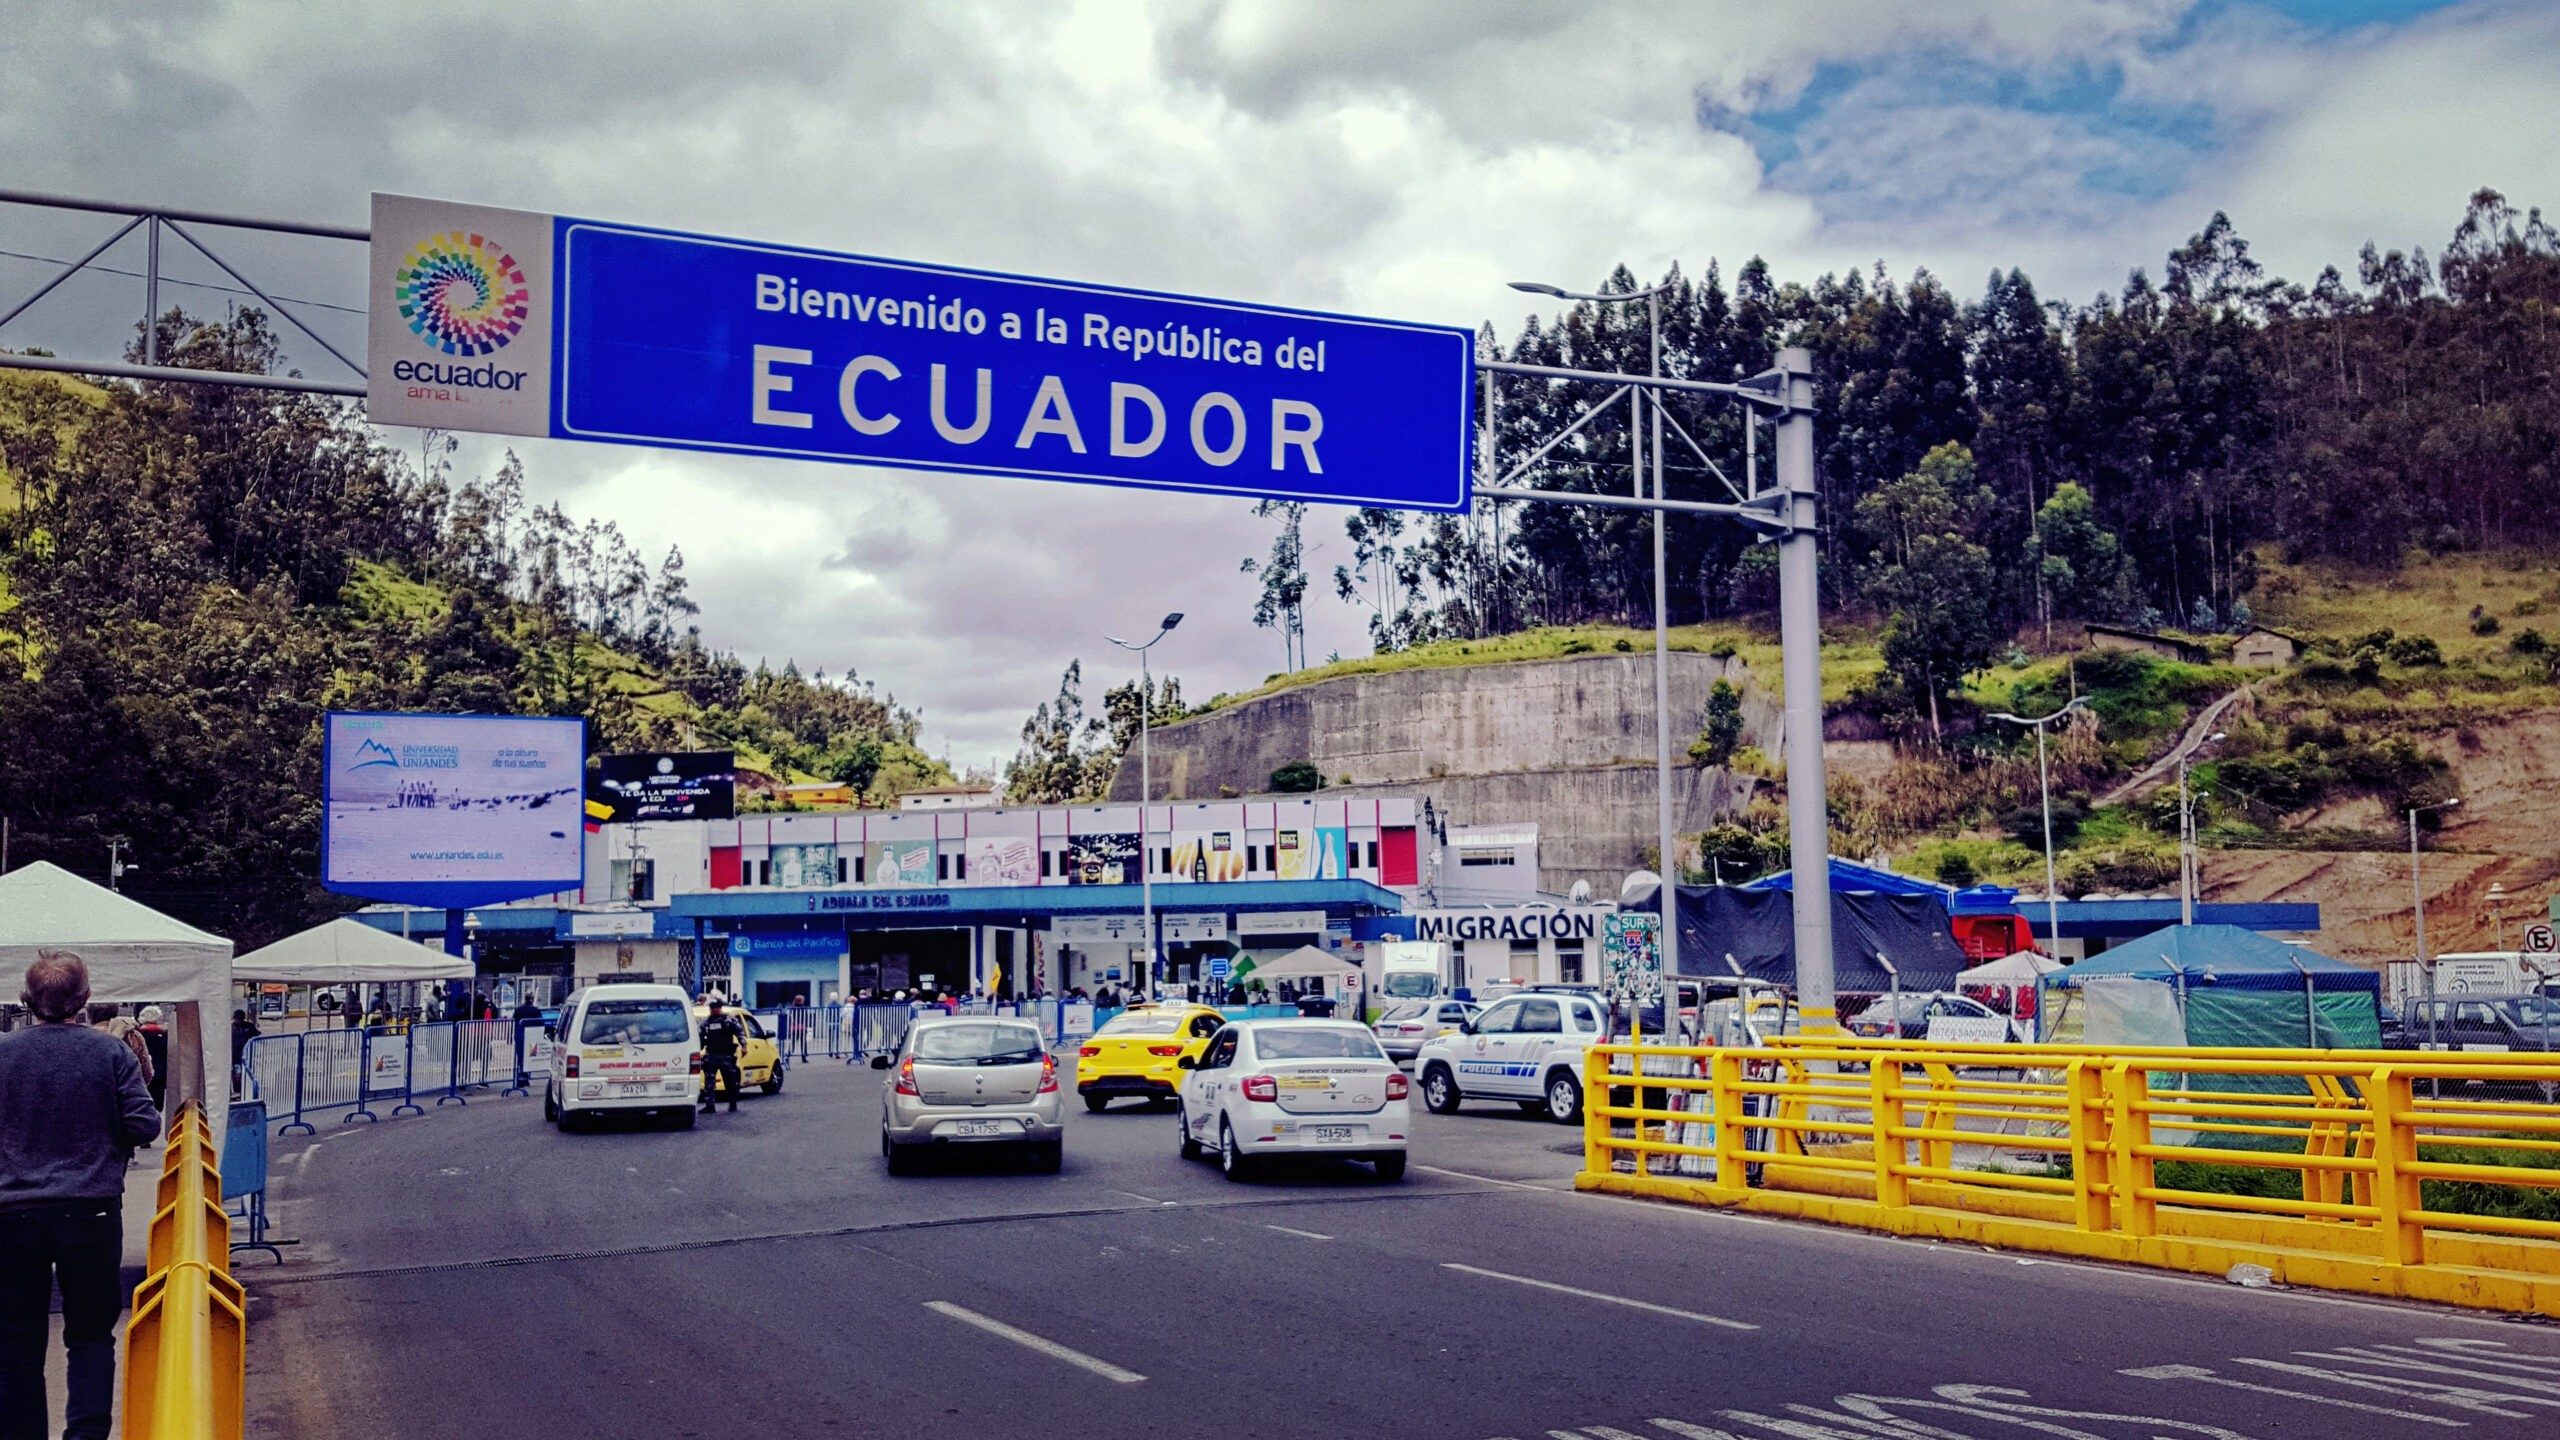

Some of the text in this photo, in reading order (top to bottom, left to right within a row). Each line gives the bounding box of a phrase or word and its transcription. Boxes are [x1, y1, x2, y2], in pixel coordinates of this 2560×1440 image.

[755, 273, 1325, 372] Bienvenido a la República del
[393, 359, 528, 391] ecuador
[407, 386, 450, 401] ama
[752, 343, 1324, 474] ECUADOR
[402, 745, 458, 753] UNIVERSIDAD
[402, 759, 458, 768] UNIANDES
[822, 893, 950, 909] ADUANA DEL ECUADOR
[1418, 908, 1595, 940] MIGRACIÓN
[1622, 917, 1644, 929] SUR
[754, 939, 783, 948] Banco
[786, 938, 800, 948] del
[2534, 931, 2549, 948] E
[1347, 975, 1355, 986] E
